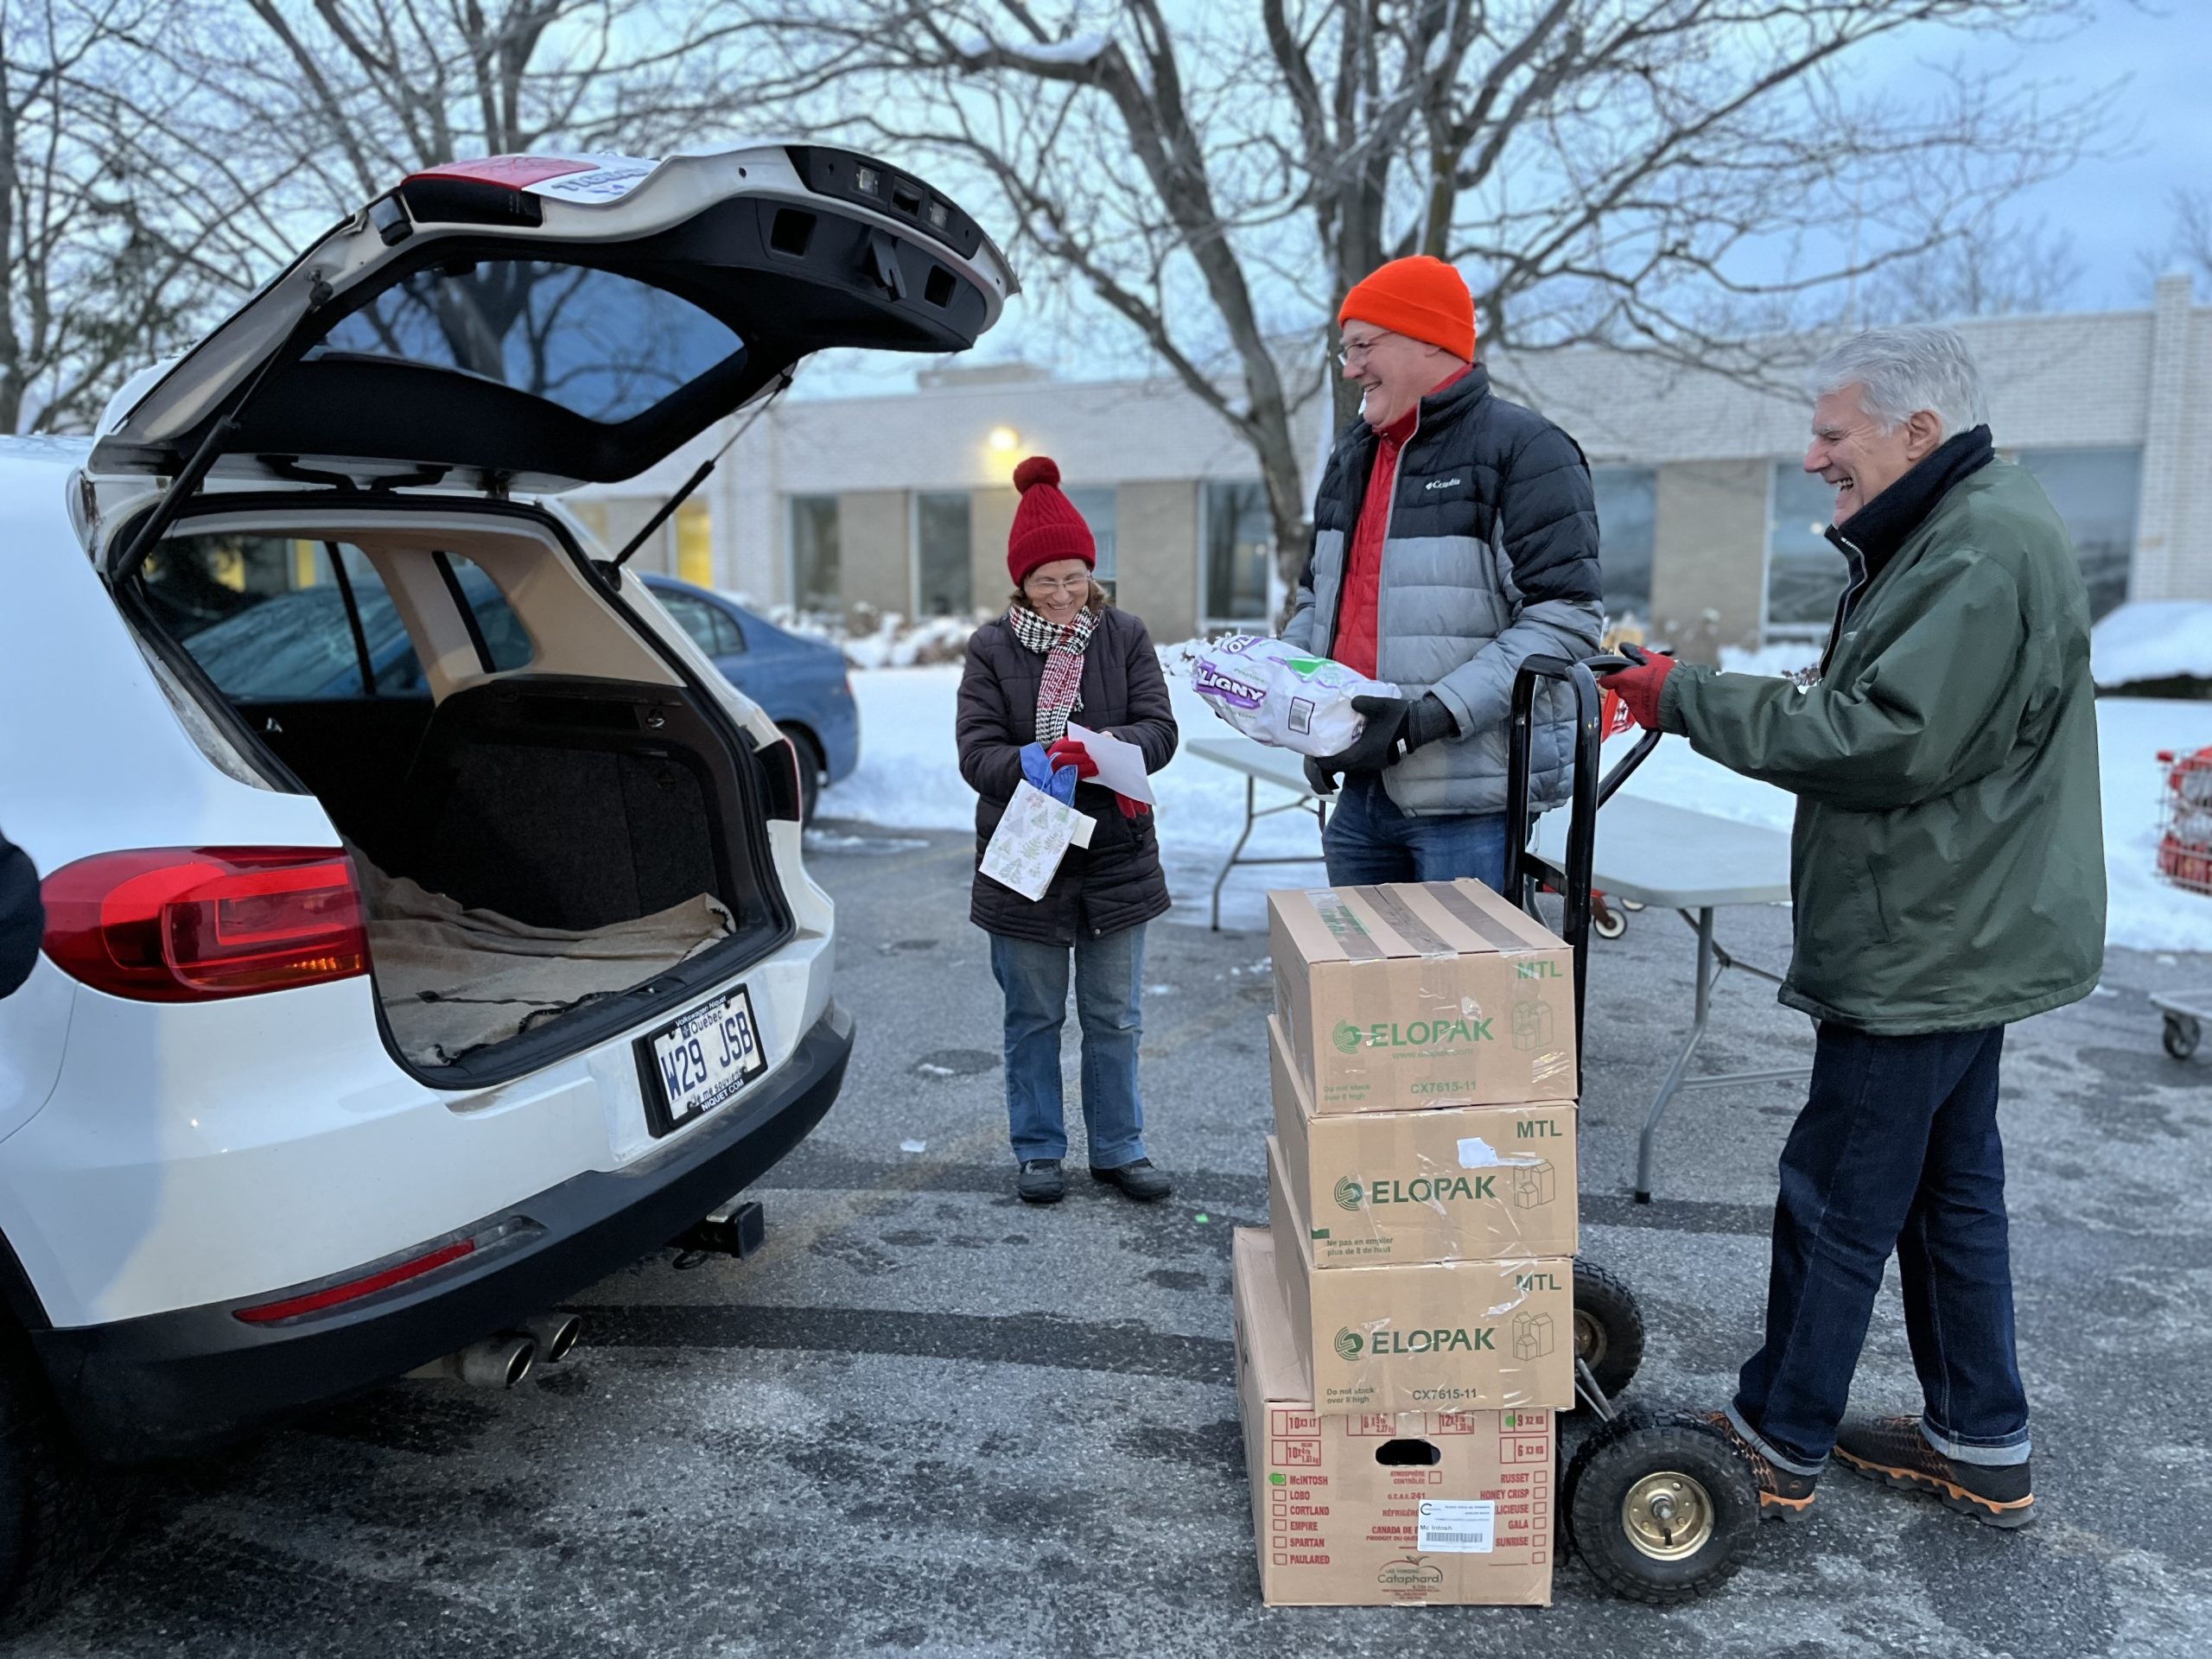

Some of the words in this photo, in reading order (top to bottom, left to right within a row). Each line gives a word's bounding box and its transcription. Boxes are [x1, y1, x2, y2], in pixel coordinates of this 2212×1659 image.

[1517, 961, 1563, 980] MTL
[675, 1005, 709, 1027] Volkswagen
[1370, 1017, 1494, 1047] ELOPAK
[661, 1039, 708, 1101] W29
[719, 1011, 753, 1068] JSB
[702, 1088, 713, 1098] me
[1410, 1081, 1477, 1094] CX7615-11
[1516, 1120, 1563, 1139] MTL
[1371, 1175, 1497, 1205] ELOPAK
[1516, 1274, 1562, 1292] MTL
[1371, 1328, 1496, 1355] ELOPAK
[1351, 1395, 1370, 1404] high
[1412, 1388, 1477, 1401] CX7615-11
[1289, 1476, 1328, 1485] McINTOSH
[1500, 1473, 1529, 1484] RUSSET
[1290, 1491, 1310, 1501] LOBO
[1480, 1490, 1506, 1499] HONEY
[1507, 1489, 1529, 1498] CRISP
[1290, 1506, 1330, 1516] CORTLAND
[1290, 1522, 1319, 1531] EMPIRE
[1508, 1520, 1529, 1529] GALA
[1290, 1538, 1325, 1548] SPARTAN
[1496, 1536, 1529, 1547] SUNRISE
[1290, 1555, 1330, 1565] PAULARED
[1377, 1574, 1440, 1585] Cataphard
